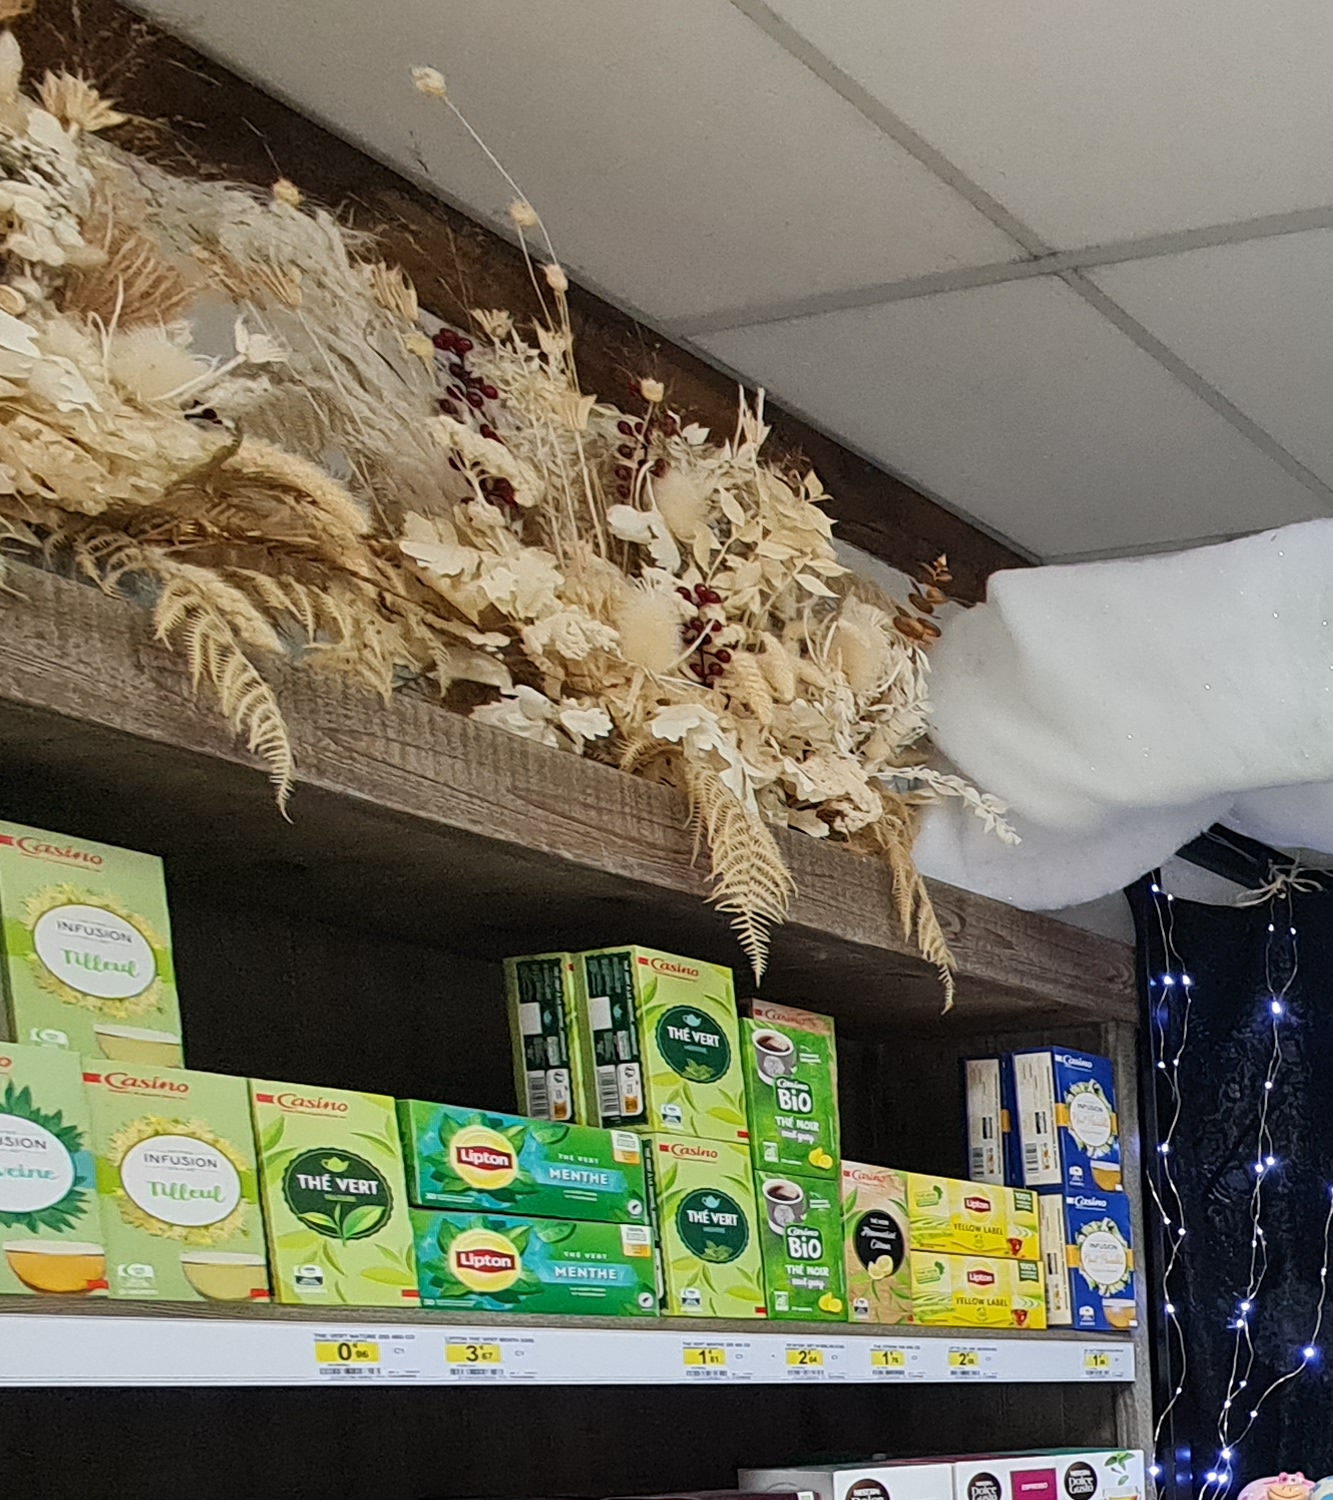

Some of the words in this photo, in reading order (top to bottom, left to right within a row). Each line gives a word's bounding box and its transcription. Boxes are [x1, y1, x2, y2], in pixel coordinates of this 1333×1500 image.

[18, 836, 104, 866] Casino
[56, 919, 133, 944] INFUSION
[62, 949, 139, 979] Tilleul
[651, 957, 699, 978] Casino
[667, 1023, 692, 1042] THÉ
[692, 1032, 720, 1048] VERT
[105, 1072, 190, 1093] Casino
[277, 1093, 350, 1113] Casino
[778, 1088, 812, 1113] BiO
[144, 1153, 218, 1169] INFUSION
[460, 1149, 509, 1167] Lipton
[671, 1143, 718, 1159] Casino
[296, 1174, 332, 1192] THÉ
[336, 1178, 379, 1195] VERT
[549, 1168, 609, 1186] MENTHE
[148, 1180, 226, 1203] Tilleul
[966, 1199, 990, 1210] Lipton
[686, 1208, 711, 1225] THÉ
[711, 1212, 738, 1227] VERT
[788, 1237, 822, 1260] BiO
[460, 1253, 512, 1269] Lipton
[554, 1265, 617, 1280] MENTHE
[969, 1271, 994, 1283] Lipton
